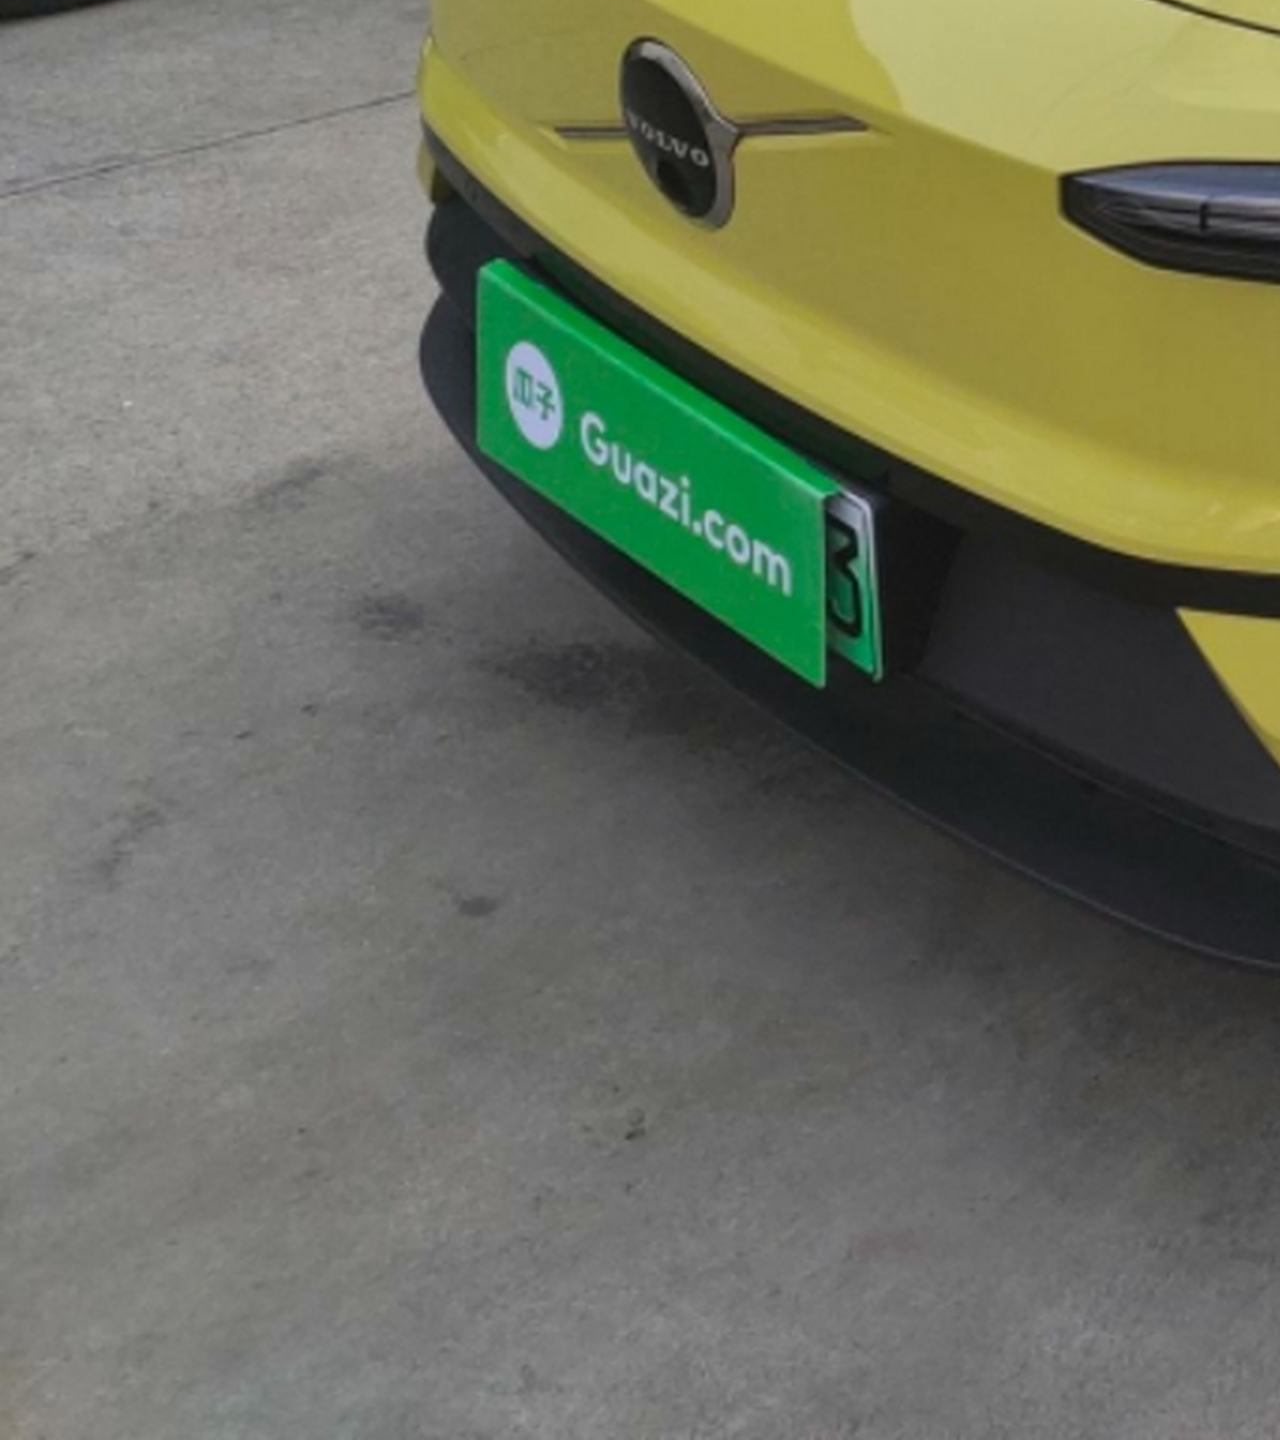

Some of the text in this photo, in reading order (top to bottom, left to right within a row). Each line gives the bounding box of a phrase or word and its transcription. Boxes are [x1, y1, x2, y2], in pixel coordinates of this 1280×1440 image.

[626, 109, 709, 168] VOLVO
[514, 367, 556, 421] 瓜子
[580, 411, 792, 597] Guazi.com
